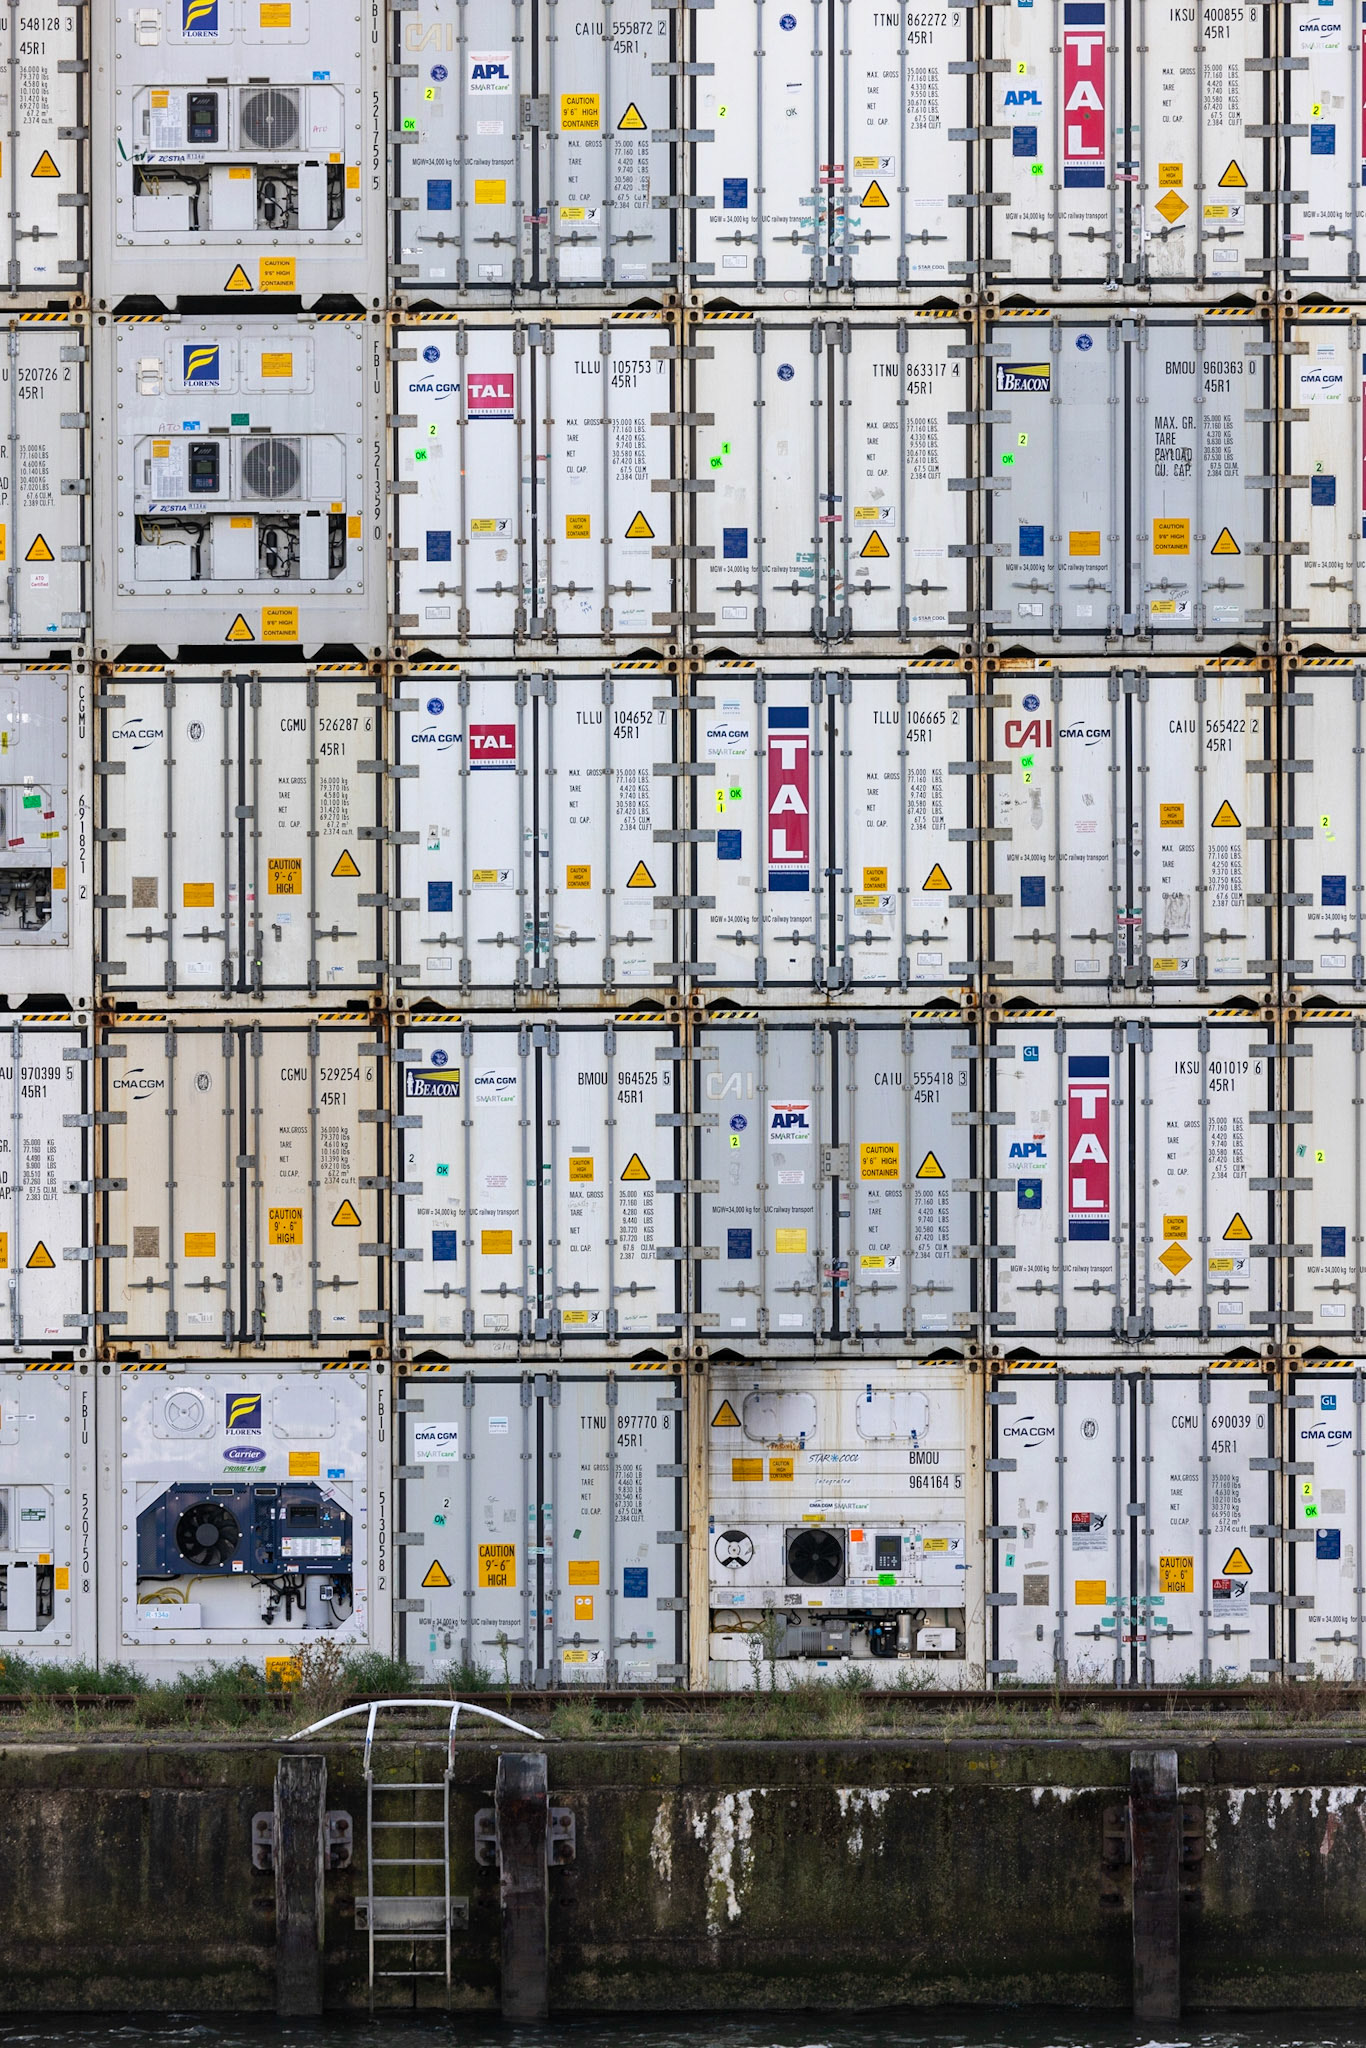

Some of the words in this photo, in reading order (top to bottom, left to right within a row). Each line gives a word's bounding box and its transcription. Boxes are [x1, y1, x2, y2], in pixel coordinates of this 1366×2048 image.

[874, 14, 899, 27] TTNU
[907, 14, 947, 27] 862272
[953, 14, 960, 27] 9
[1170, 9, 1194, 21] IKSU
[1204, 9, 1243, 21] 400855
[1250, 9, 1256, 21] 8
[20, 18, 60, 31] 548128
[66, 18, 73, 31] 3
[576, 23, 603, 35] CAIU
[613, 22, 652, 35] 555872
[659, 22, 665, 35] 2
[907, 31, 933, 44] 45R1
[1204, 26, 1230, 39] 45R1
[20, 42, 45, 55] 45R1
[613, 41, 639, 53] 45R1
[472, 64, 509, 79] APL
[426, 90, 432, 99] 2
[1065, 36, 1104, 155] TAL
[567, 97, 594, 105] CAUTION
[404, 120, 415, 129] OK
[373, 177, 378, 190] 5
[575, 361, 600, 374] TLLU
[613, 361, 651, 373] 105753
[658, 361, 664, 373] 7
[873, 364, 898, 377] TTNU
[906, 364, 946, 377] 863317
[953, 364, 959, 377] 4
[1165, 362, 1195, 374] BMOU
[1203, 361, 1243, 374] 960363
[1249, 361, 1255, 374] 0
[18, 368, 57, 381] 520726
[64, 368, 70, 380] 2
[612, 375, 637, 387] 45R1
[1004, 375, 1049, 390] BEACON
[1204, 380, 1230, 392] 45R1
[18, 387, 44, 399] 45R1
[409, 384, 433, 392] CMA
[436, 384, 460, 392] CGM
[468, 385, 510, 397] TAL
[907, 382, 932, 394] 45R1
[1155, 433, 1176, 445] TARE
[415, 451, 426, 459] OK
[374, 527, 380, 539] 0
[577, 712, 602, 724] TLLU
[614, 711, 652, 724] 104652
[659, 712, 665, 724] 7
[874, 712, 899, 724] TLLU
[907, 711, 945, 724] 106665
[952, 712, 958, 724] 2
[281, 719, 306, 731] CGMU
[319, 719, 358, 731] 526287
[365, 719, 371, 730] 6
[1169, 721, 1195, 733] CAIU
[1206, 720, 1245, 733] 565422
[1252, 721, 1258, 733] 2
[112, 730, 136, 738] CMA
[139, 730, 163, 738] CGM
[438, 734, 462, 742] CGM
[614, 726, 639, 739] 45R1
[907, 729, 932, 742] 45R1
[1005, 720, 1051, 748] CAI
[471, 736, 512, 748] TAL
[1206, 739, 1231, 751] 45R1
[320, 743, 346, 755] 45R1
[730, 789, 741, 798] OK
[770, 740, 808, 858] TAL
[269, 860, 301, 870] CAUTION
[80, 886, 86, 899] 2
[277, 883, 293, 893] HIGH
[727, 915, 742, 923] 34,000
[772, 915, 789, 924] railway
[790, 915, 812, 924] transport
[1024, 1048, 1038, 1057] GL
[21, 1068, 60, 1080] 970399
[66, 1067, 73, 1080] 5
[1175, 1062, 1199, 1074] IKSU
[1209, 1062, 1248, 1074] 401019
[1255, 1062, 1261, 1074] 6
[281, 1069, 307, 1081] CGMU
[320, 1068, 360, 1080] 529254
[366, 1068, 372, 1080] 6
[578, 1072, 607, 1085] BMOU
[618, 1072, 658, 1085] 964525
[663, 1072, 670, 1084] 5
[875, 1073, 902, 1085] CAIU
[914, 1073, 953, 1085] 555418
[960, 1073, 966, 1085] 3
[414, 1082, 459, 1096] BEACON
[1209, 1079, 1235, 1092] 45R1
[21, 1086, 47, 1098] 45R1
[617, 1090, 644, 1103] 45R1
[914, 1090, 939, 1103] 45R1
[321, 1093, 346, 1105] 45R1
[772, 1114, 809, 1128] APL
[733, 1137, 738, 1146] 2
[1070, 1089, 1108, 1208] TAL
[581, 1416, 606, 1429] TTNU
[617, 1416, 657, 1429] 897770
[663, 1416, 670, 1429] 8
[1172, 1416, 1198, 1429] CGMU
[1212, 1416, 1250, 1429] 690039
[1258, 1416, 1264, 1428] 0
[437, 1432, 457, 1440] CGM
[617, 1434, 642, 1447] 45R1
[1301, 1431, 1325, 1439] CMA
[1328, 1431, 1352, 1439] CGM
[1212, 1441, 1236, 1453] 45R1
[229, 1450, 260, 1459] Carrier
[910, 1452, 939, 1464] BMOU
[910, 1476, 949, 1488] 964164
[955, 1476, 961, 1488] 5
[1304, 1485, 1309, 1494] 2
[1305, 1507, 1317, 1516] OK
[480, 1546, 514, 1557] CAUTION
[379, 1577, 385, 1589] 2
[488, 1574, 506, 1585] HIGH
[83, 1580, 89, 1592] 8
